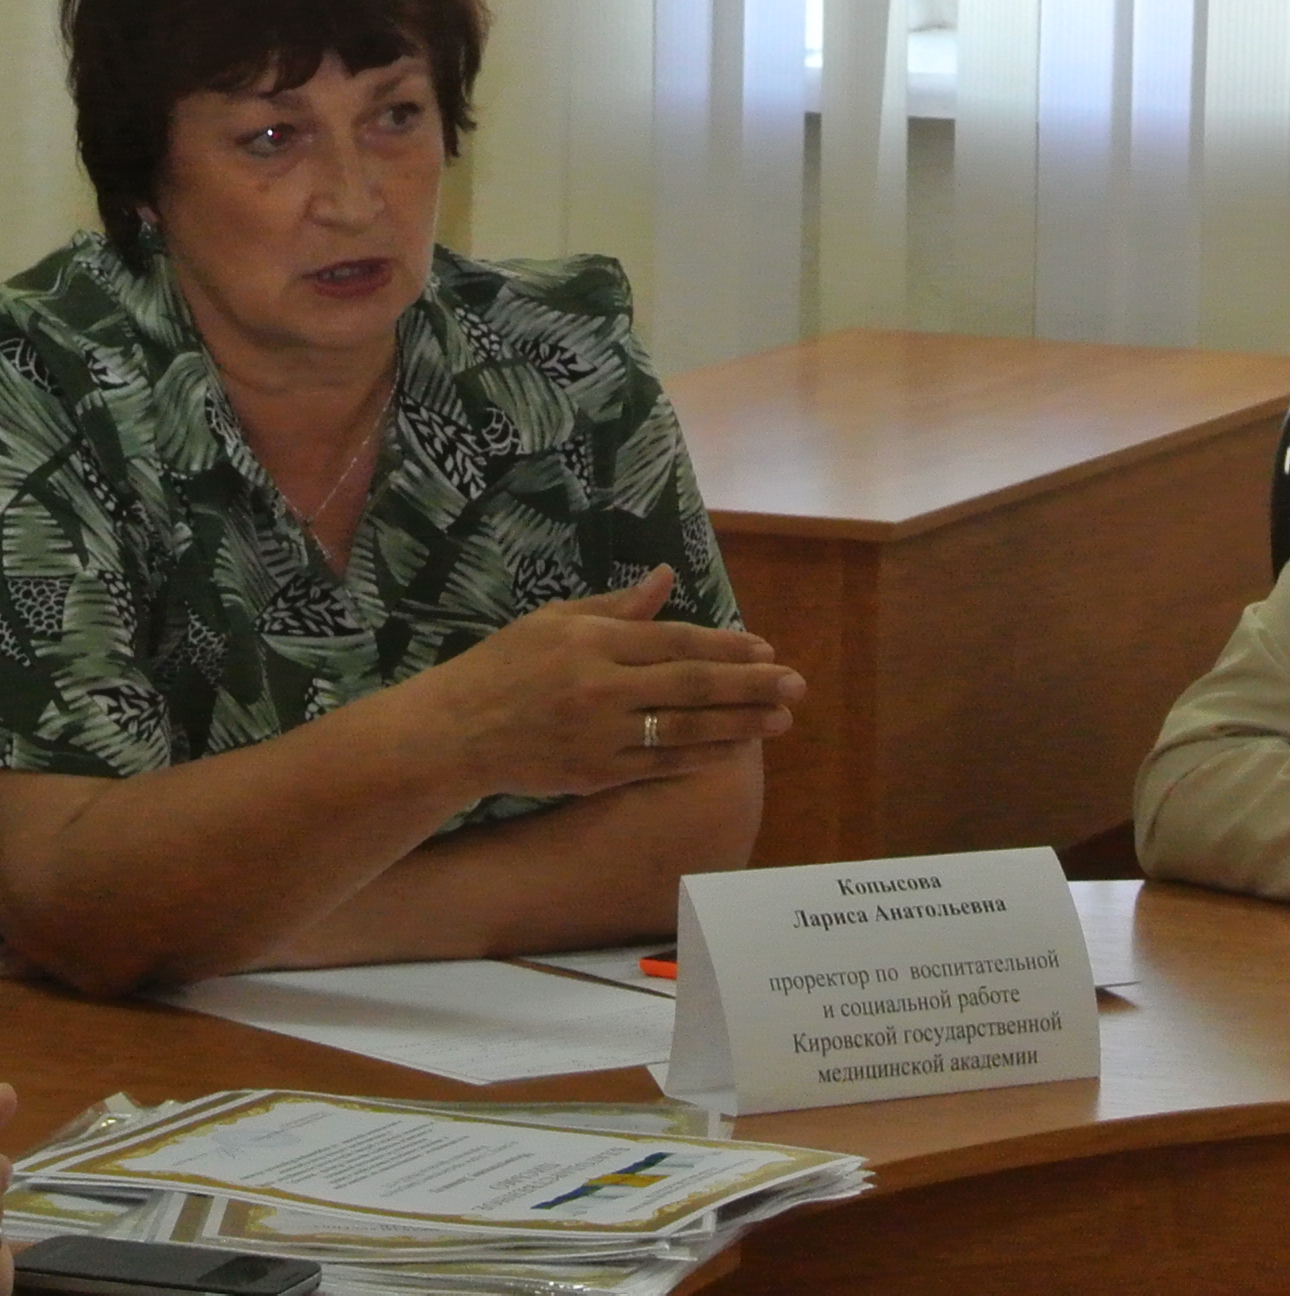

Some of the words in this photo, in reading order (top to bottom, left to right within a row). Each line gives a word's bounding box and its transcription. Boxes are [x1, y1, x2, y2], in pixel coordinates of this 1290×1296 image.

[837, 874, 942, 896] Копысова
[793, 908, 869, 930] Лариса
[874, 897, 1007, 923] Анатольевна
[768, 968, 870, 995] проректор
[875, 967, 899, 985] по
[909, 949, 1060, 981] воспитательной
[823, 1004, 835, 1019] и
[840, 989, 953, 1019] социальной
[957, 987, 1021, 1013] работе
[793, 1025, 898, 1056] Кировской
[904, 1011, 1063, 1046] государственной
[817, 1054, 945, 1084] медицинской
[950, 1049, 1039, 1074] академии
